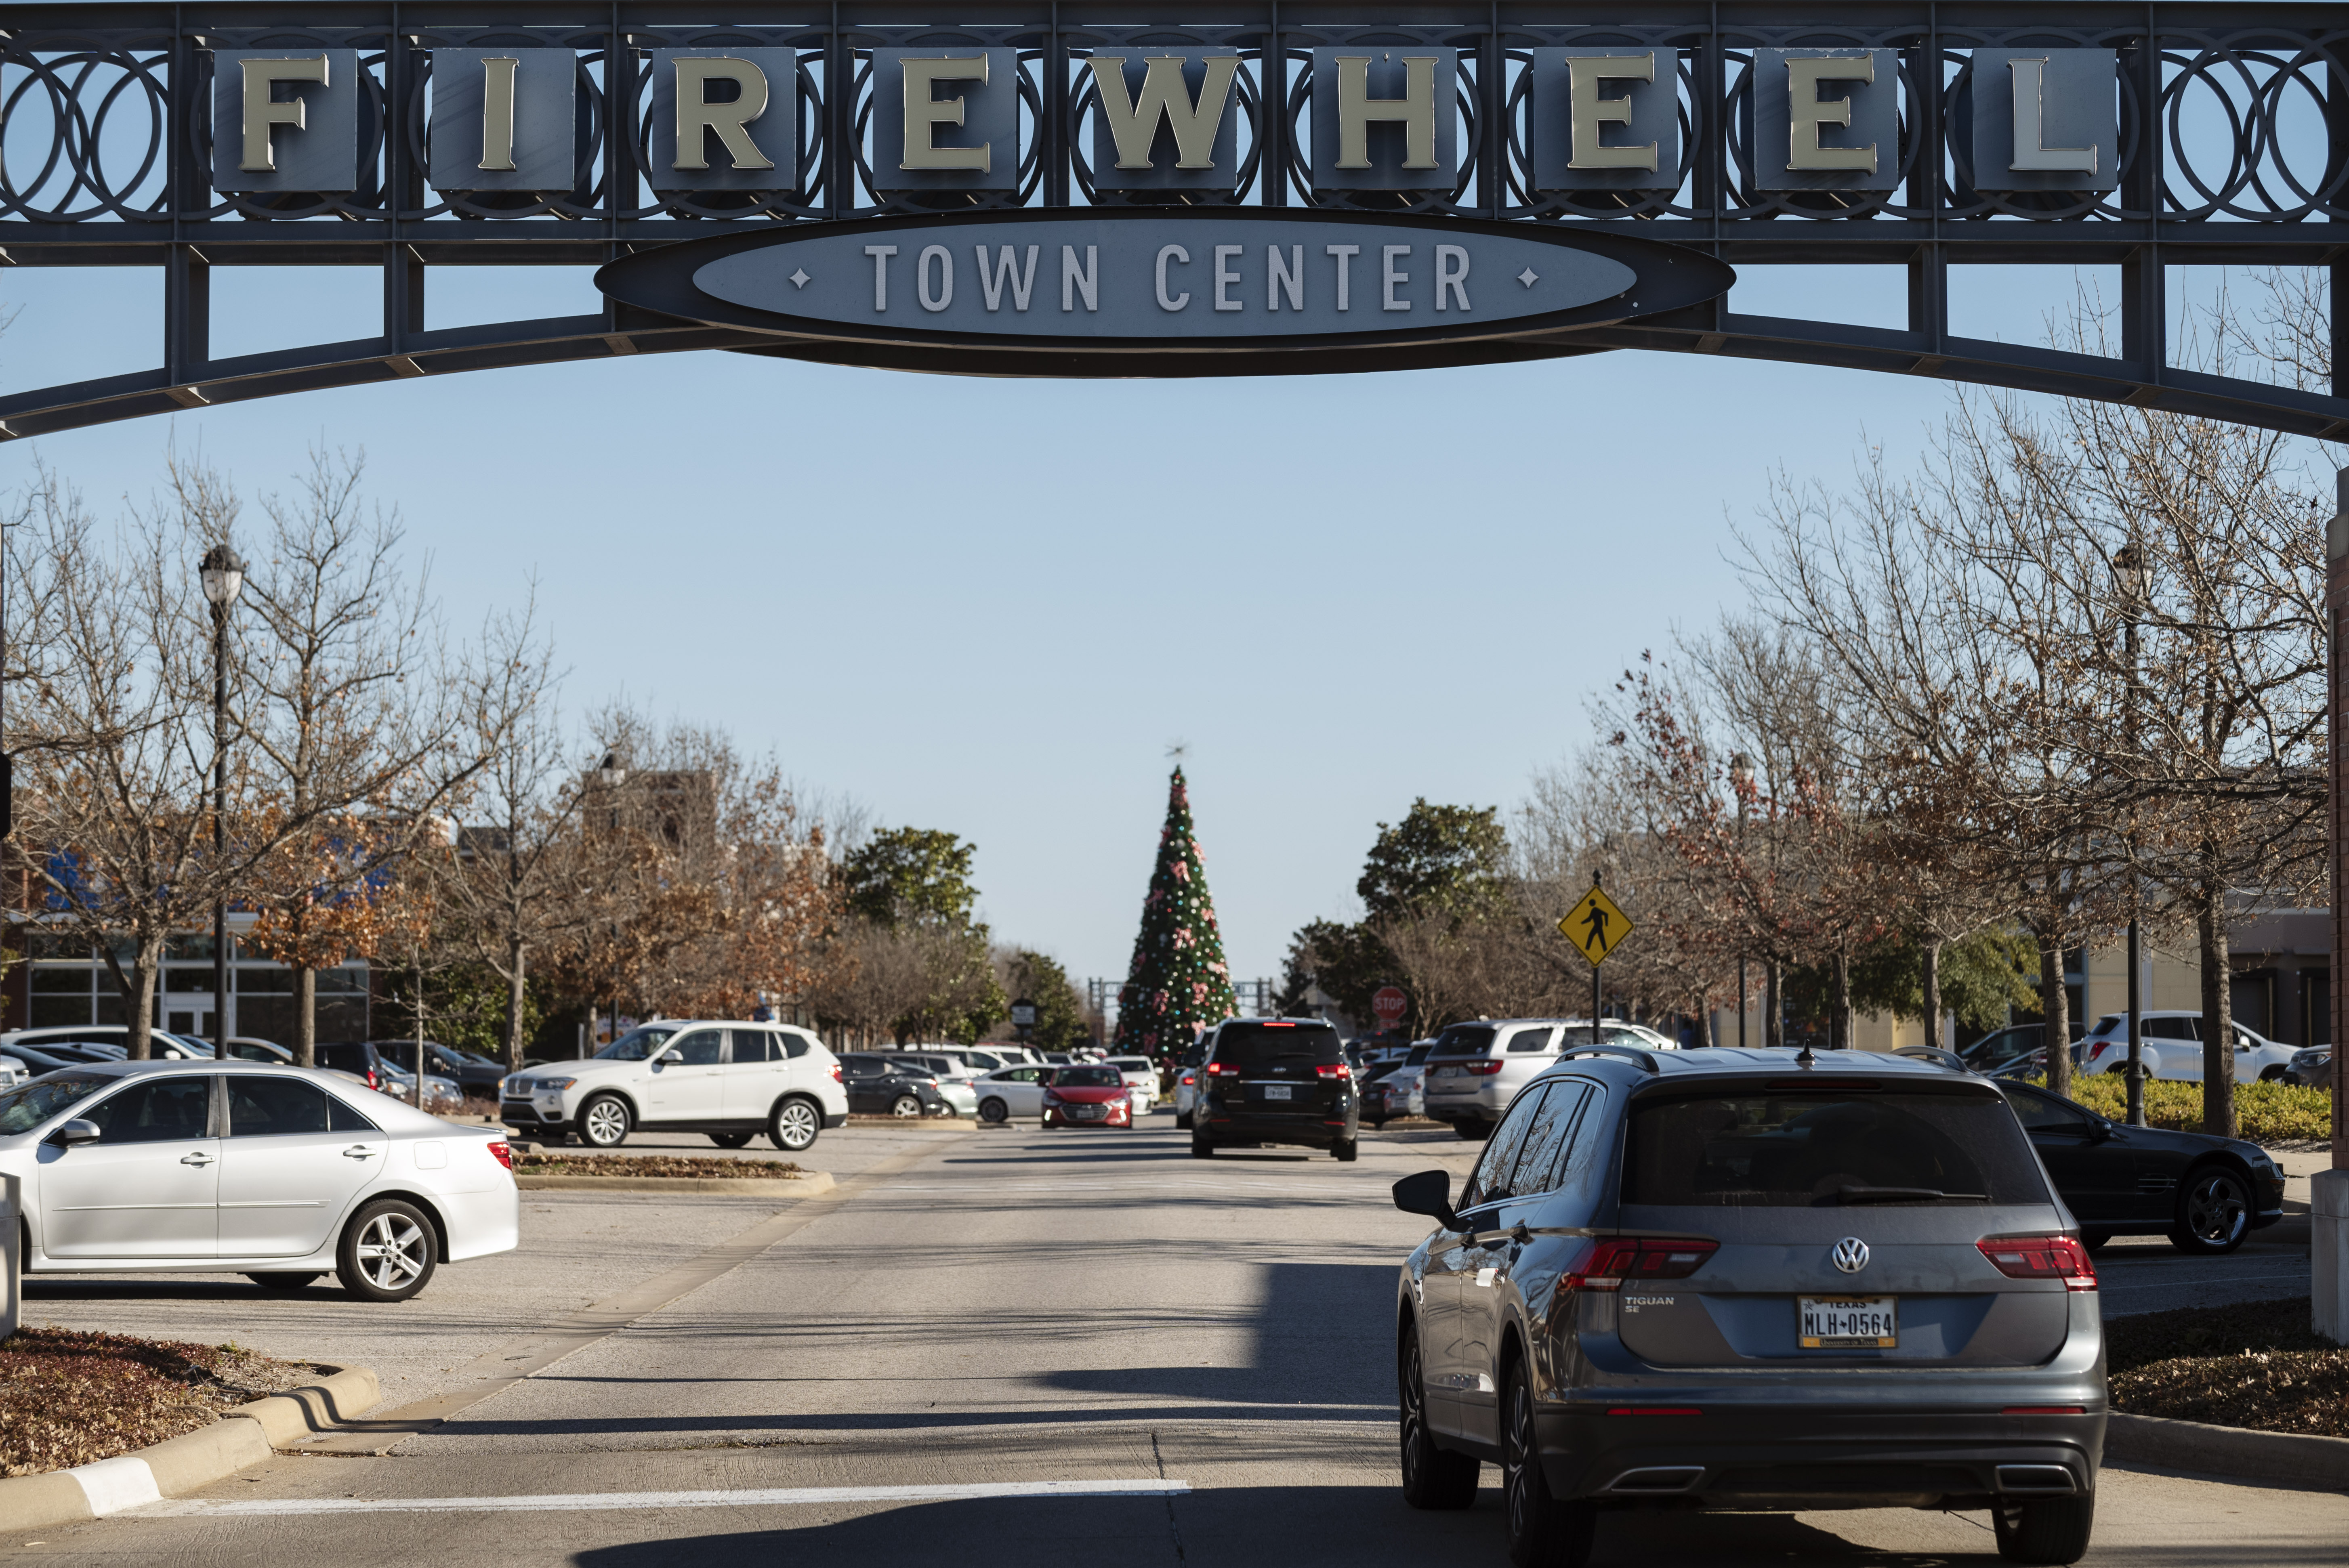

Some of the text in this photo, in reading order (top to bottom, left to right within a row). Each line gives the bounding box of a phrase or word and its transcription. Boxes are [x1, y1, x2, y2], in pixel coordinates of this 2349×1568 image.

[237, 51, 2098, 177] FIREWHEEL
[864, 244, 1472, 312] TOWN CENTER
[1375, 997, 1405, 1010] STOP
[1624, 1296, 1675, 1305] TIGUAN
